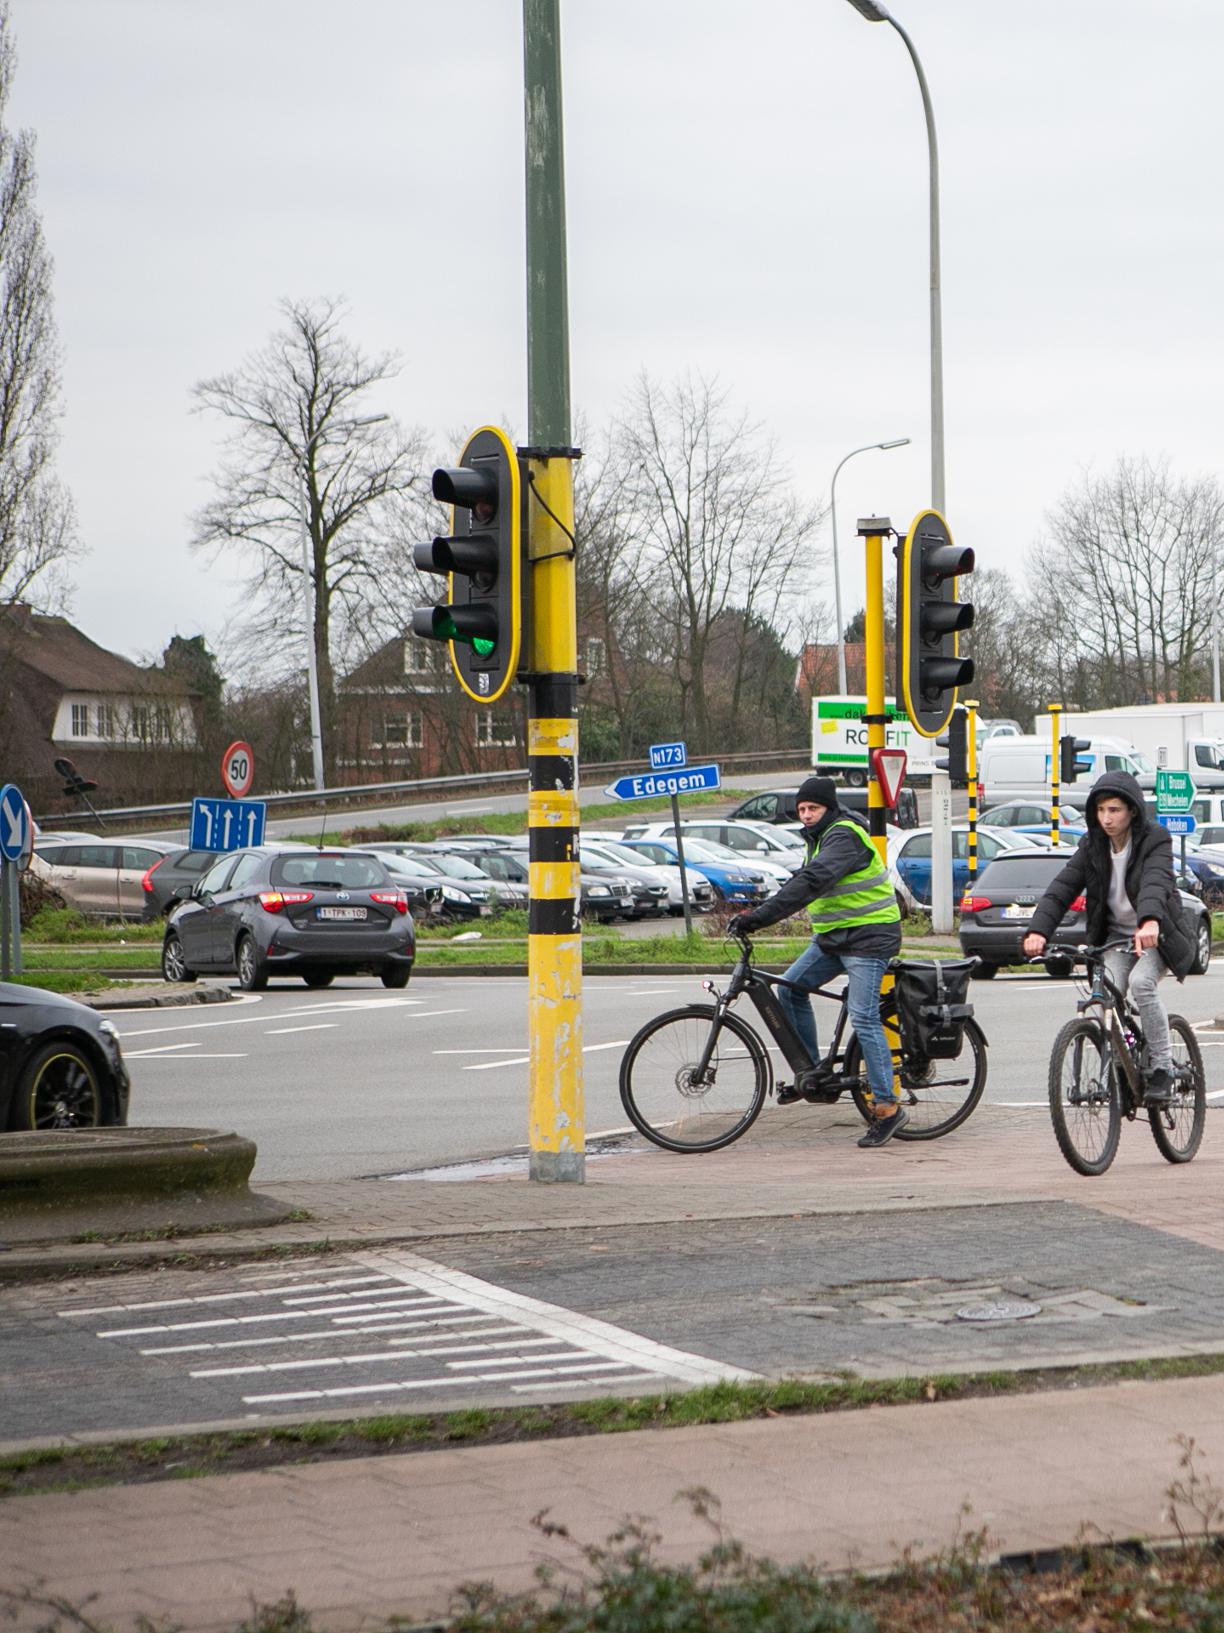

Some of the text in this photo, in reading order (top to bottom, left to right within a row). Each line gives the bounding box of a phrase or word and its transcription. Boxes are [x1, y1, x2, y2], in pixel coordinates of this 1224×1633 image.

[846, 729, 911, 747] ROFIT
[653, 748, 682, 764] N173
[231, 759, 247, 780] 50
[632, 773, 705, 796] Edegem
